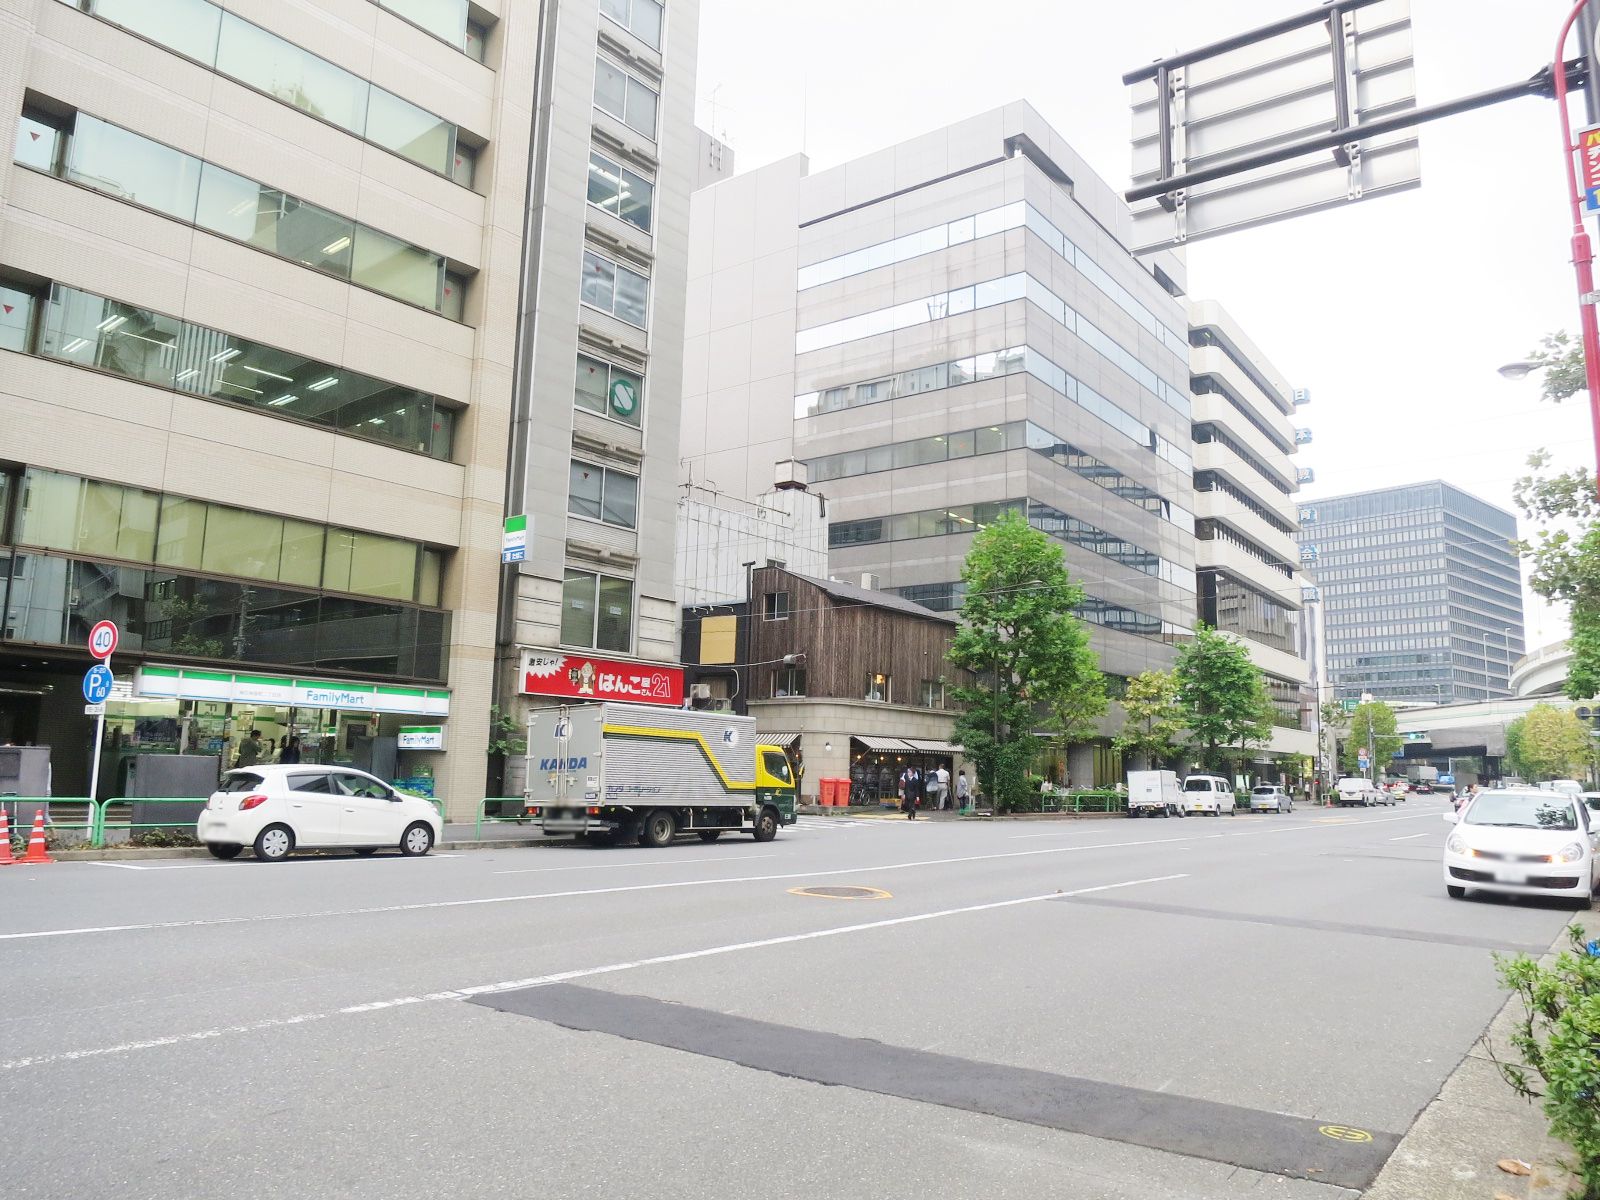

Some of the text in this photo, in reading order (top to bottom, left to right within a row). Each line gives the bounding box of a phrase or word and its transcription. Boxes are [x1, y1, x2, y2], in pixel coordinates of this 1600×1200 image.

[95, 631, 111, 647] 40
[89, 674, 102, 697] P
[96, 686, 105, 698] 60
[306, 690, 365, 704] FamilyMart
